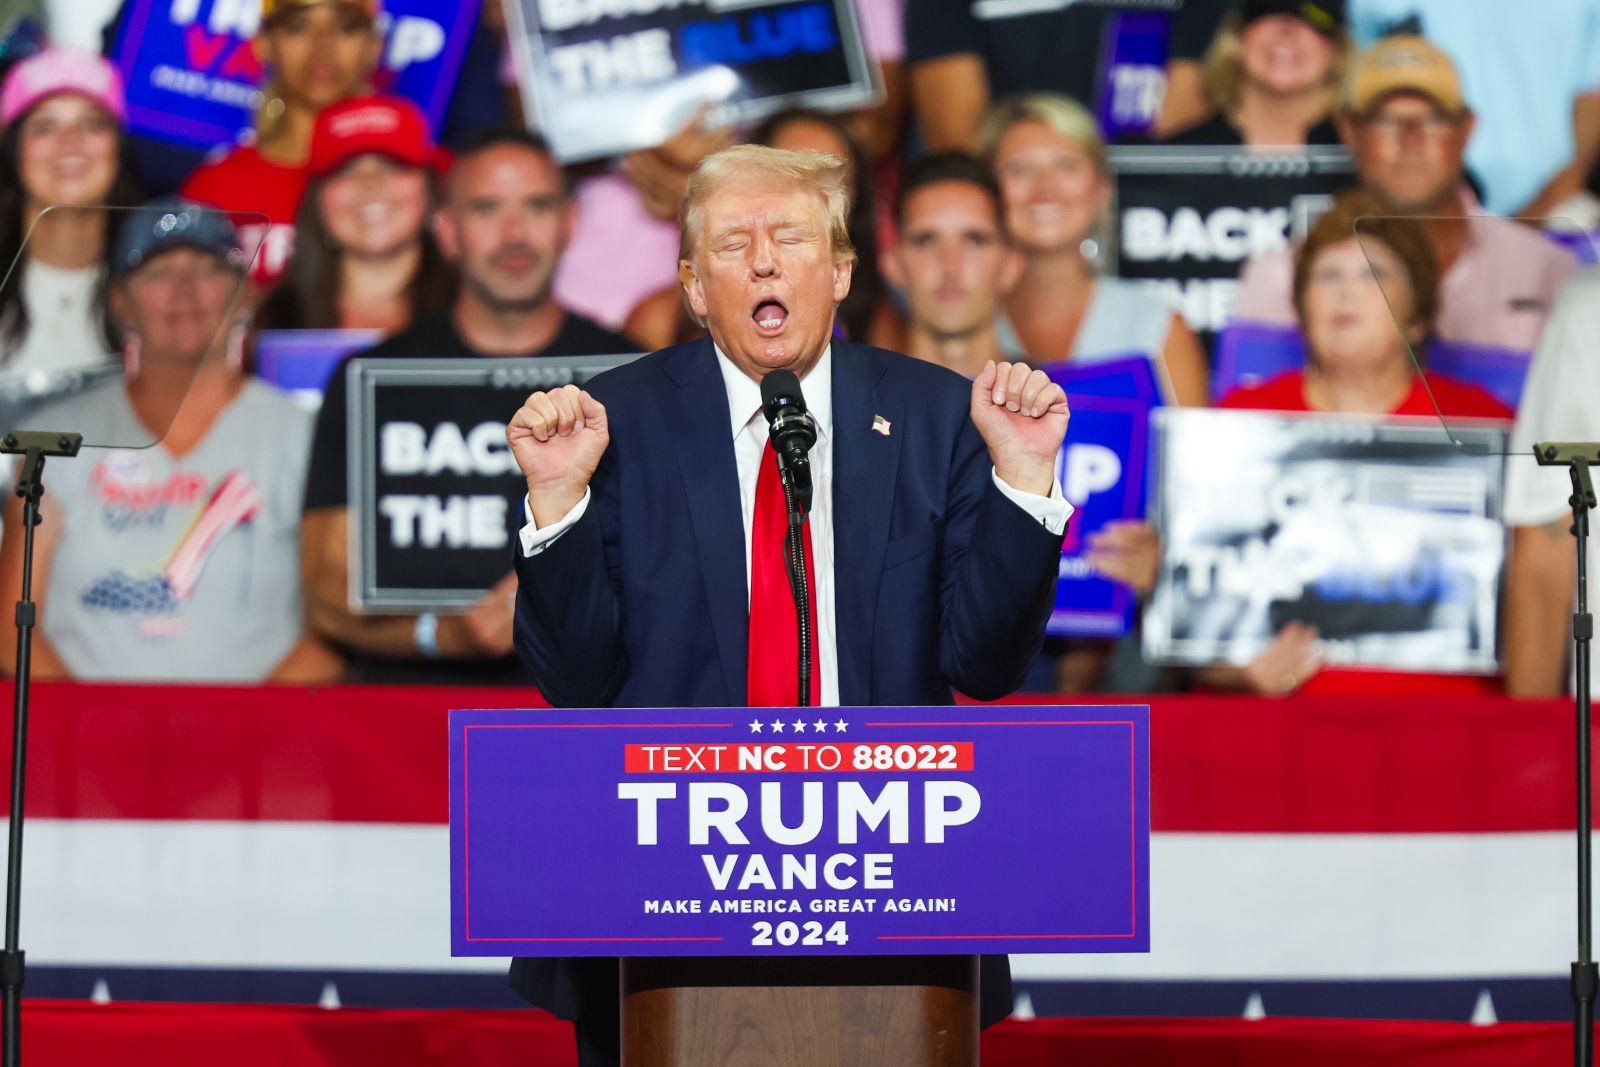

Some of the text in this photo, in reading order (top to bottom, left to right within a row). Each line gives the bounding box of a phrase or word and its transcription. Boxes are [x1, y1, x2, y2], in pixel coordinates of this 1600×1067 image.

[679, 4, 837, 65] BLUE
[1122, 206, 1290, 262] BACK
[380, 421, 523, 476] BAC
[381, 494, 509, 549] THE
[642, 744, 958, 771] TEXT NC TO 88022
[618, 780, 981, 846] TRUMP
[702, 853, 894, 891] VANCE
[644, 898, 957, 914] MAKE AMERICA GREAT AGAIN!
[751, 920, 849, 946] 2024
